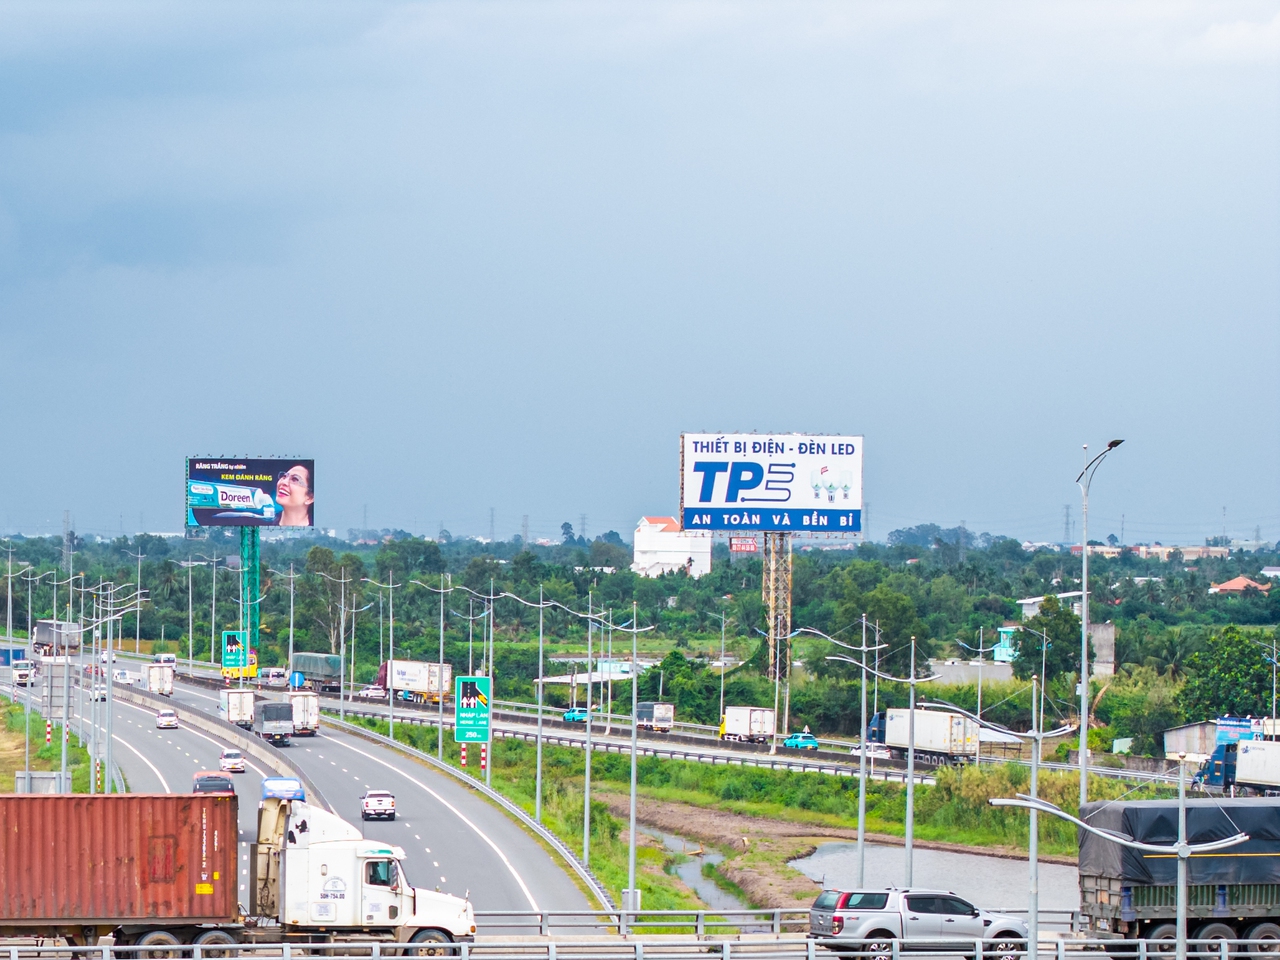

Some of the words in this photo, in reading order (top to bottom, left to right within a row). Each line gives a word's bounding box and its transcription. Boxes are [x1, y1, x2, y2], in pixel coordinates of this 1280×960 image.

[693, 436, 729, 453] THIẾT
[734, 442, 747, 456] BỊ
[752, 439, 784, 457] ĐIỆN
[798, 439, 825, 455] ĐÈN
[832, 443, 855, 455] LED
[220, 491, 250, 503] Doreen
[692, 514, 711, 524] AN
[723, 512, 760, 525] TOÀN
[772, 513, 790, 525] VÀ
[803, 511, 827, 526] BỀN
[840, 513, 853, 526] BỈ
